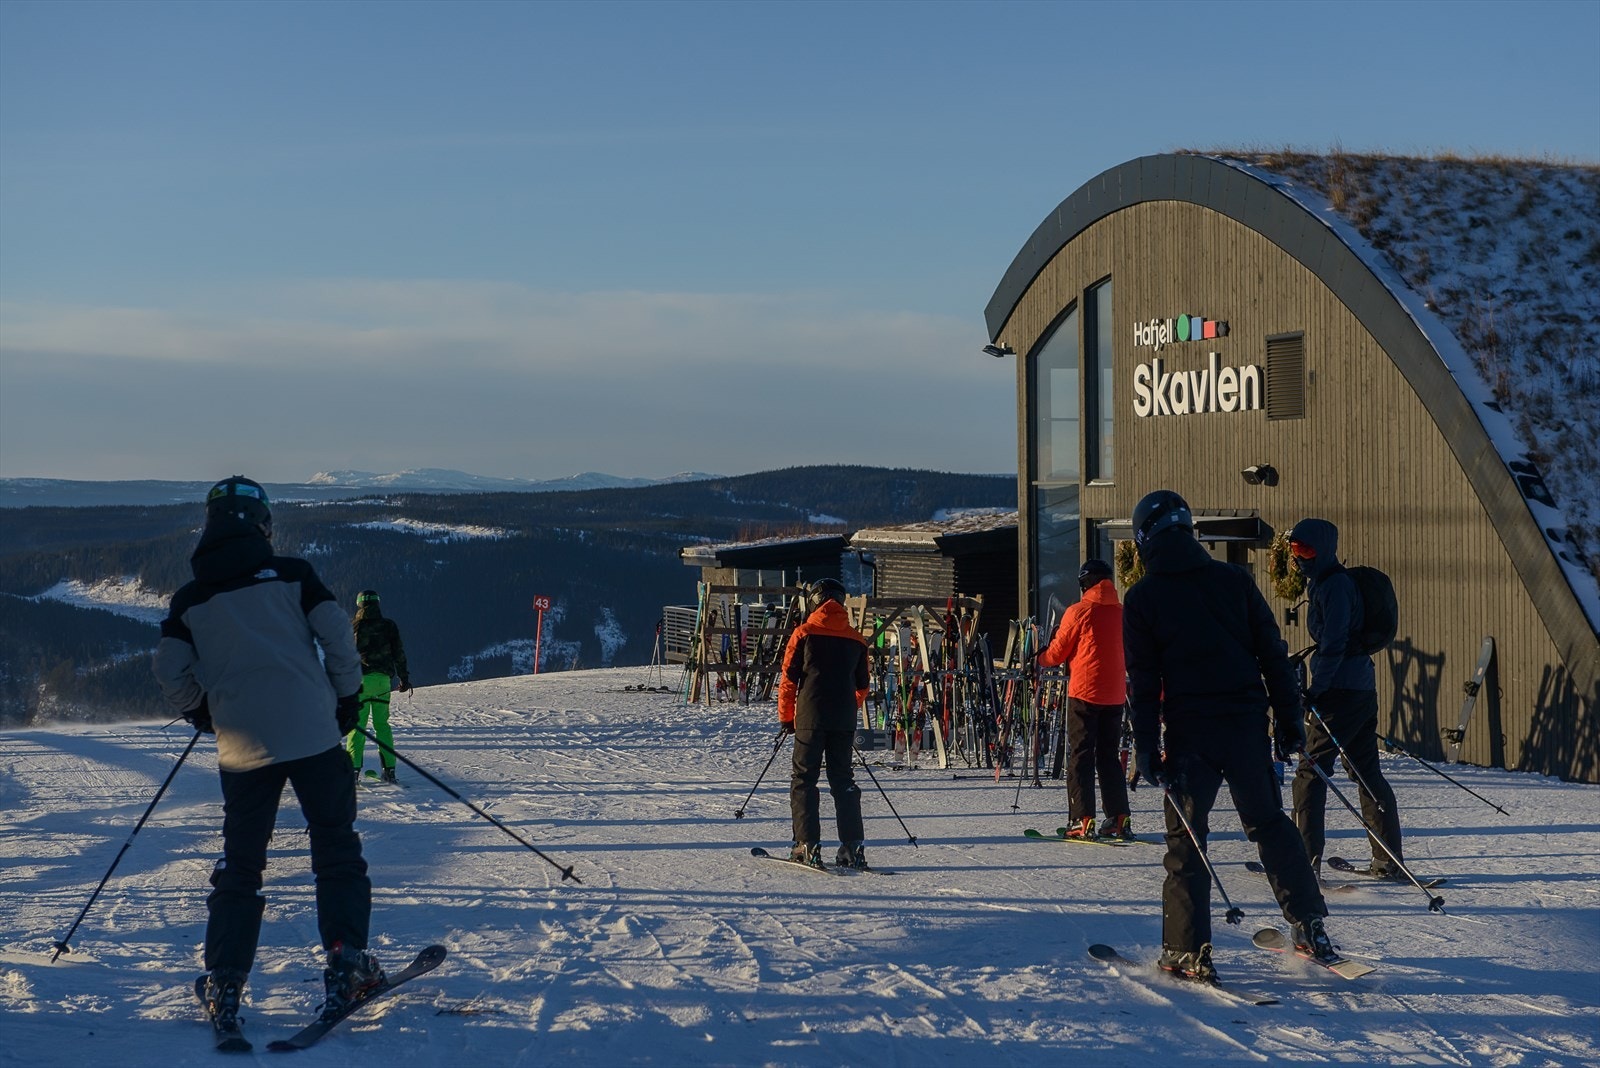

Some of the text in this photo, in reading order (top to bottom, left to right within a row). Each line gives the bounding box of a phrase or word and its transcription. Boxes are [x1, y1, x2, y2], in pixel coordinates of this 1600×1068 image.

[1134, 318, 1173, 351] Hafjell
[1133, 352, 1260, 418] Skavlen
[535, 598, 549, 609] 43
